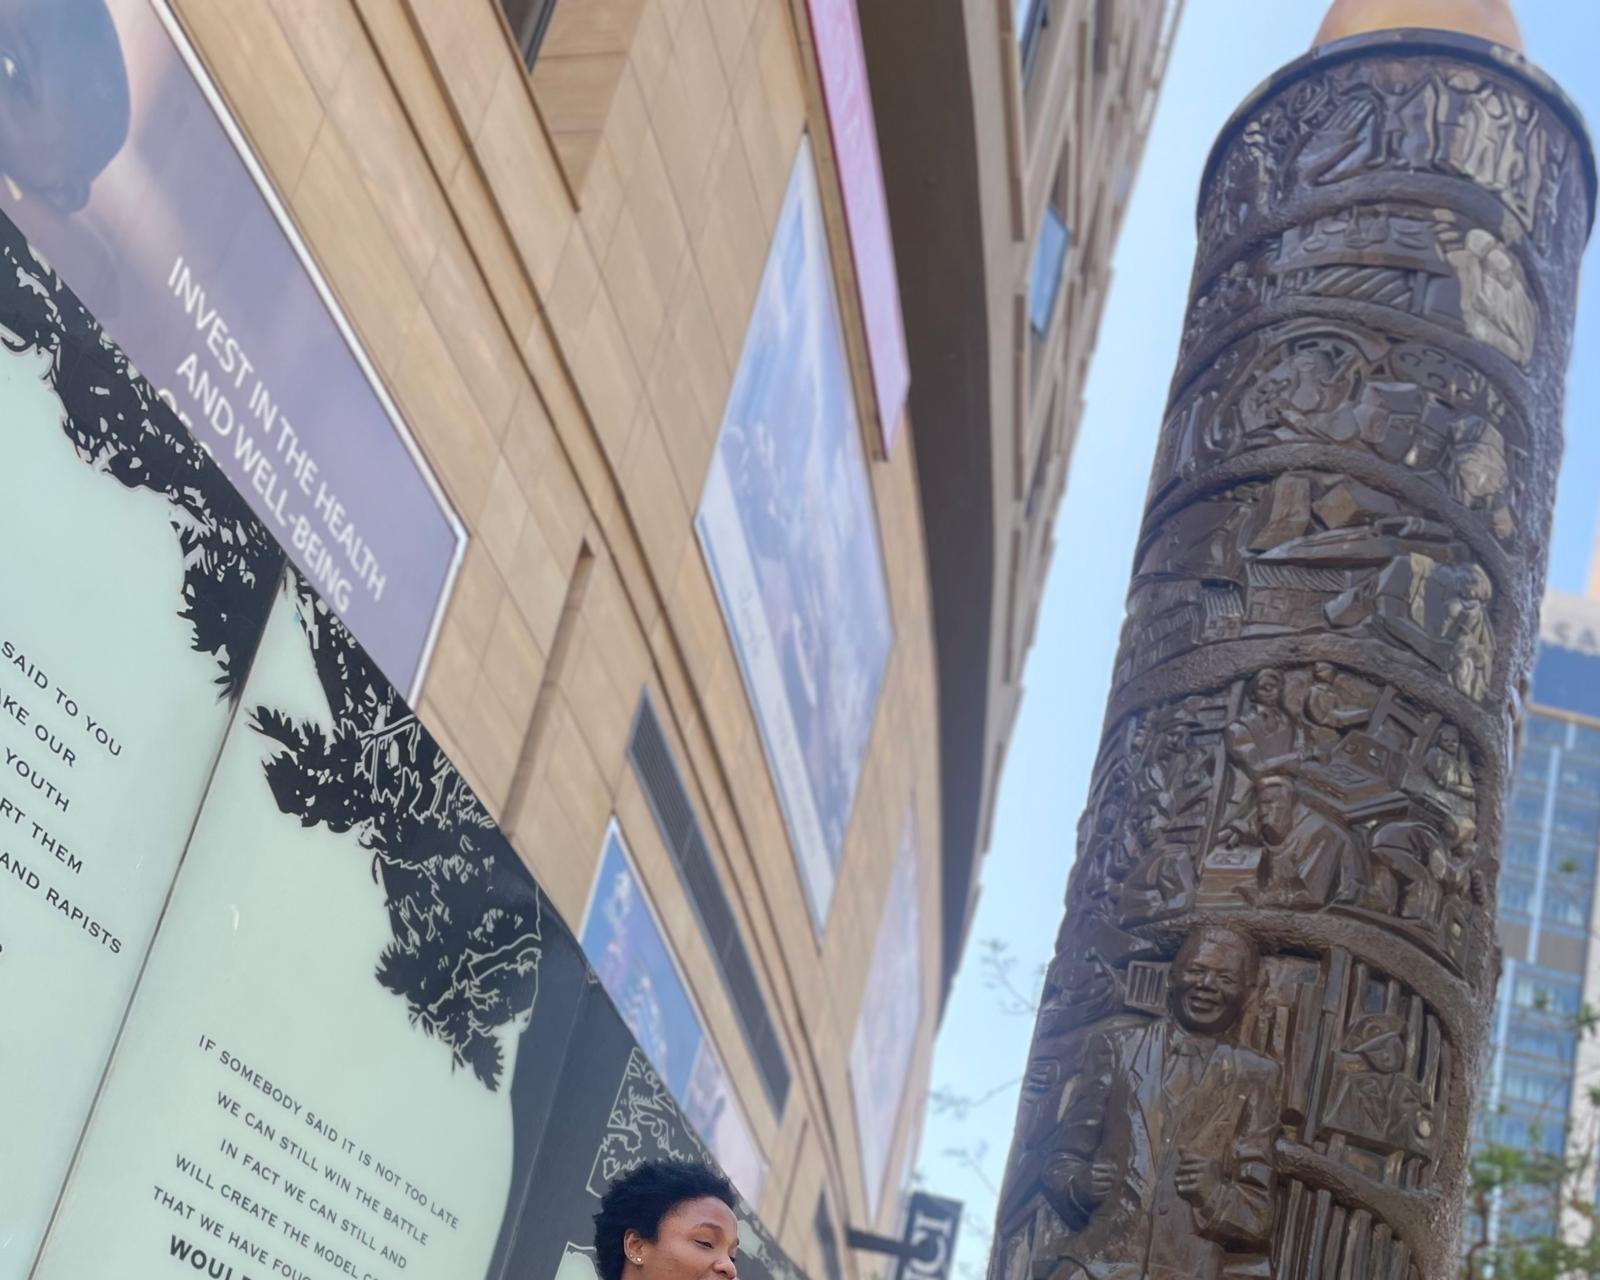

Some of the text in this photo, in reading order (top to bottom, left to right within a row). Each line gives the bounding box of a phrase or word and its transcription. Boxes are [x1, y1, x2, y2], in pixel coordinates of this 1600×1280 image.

[167, 256, 253, 384] INVEST
[249, 382, 293, 433] IN
[273, 418, 318, 492] THE
[314, 486, 387, 600] HEALTH
[176, 353, 235, 432] AND
[234, 423, 351, 613] WELL-BEING
[0, 688, 76, 767] KE OUR
[1, 641, 122, 756] SAID TO YOU
[5, 748, 70, 812] YOUTH
[0, 852, 122, 953] AND RAPISTS
[31, 822, 82, 874] THEM
[199, 1034, 460, 1229] IF SOMEBODY SAID IT IS NOT TOO LATE
[217, 1091, 429, 1246] WE CAN STILL WIN THE BATTLE
[153, 1186, 196, 1221] THAT
[199, 1214, 225, 1238] WE
[228, 1231, 268, 1264] HAVE
[176, 1153, 214, 1190] WILL
[220, 1184, 278, 1228] CREATE
[282, 1221, 309, 1248] THE
[313, 1243, 359, 1279] MODEL
[220, 1139, 408, 1269] IN FACT WE CAN STILL AND
